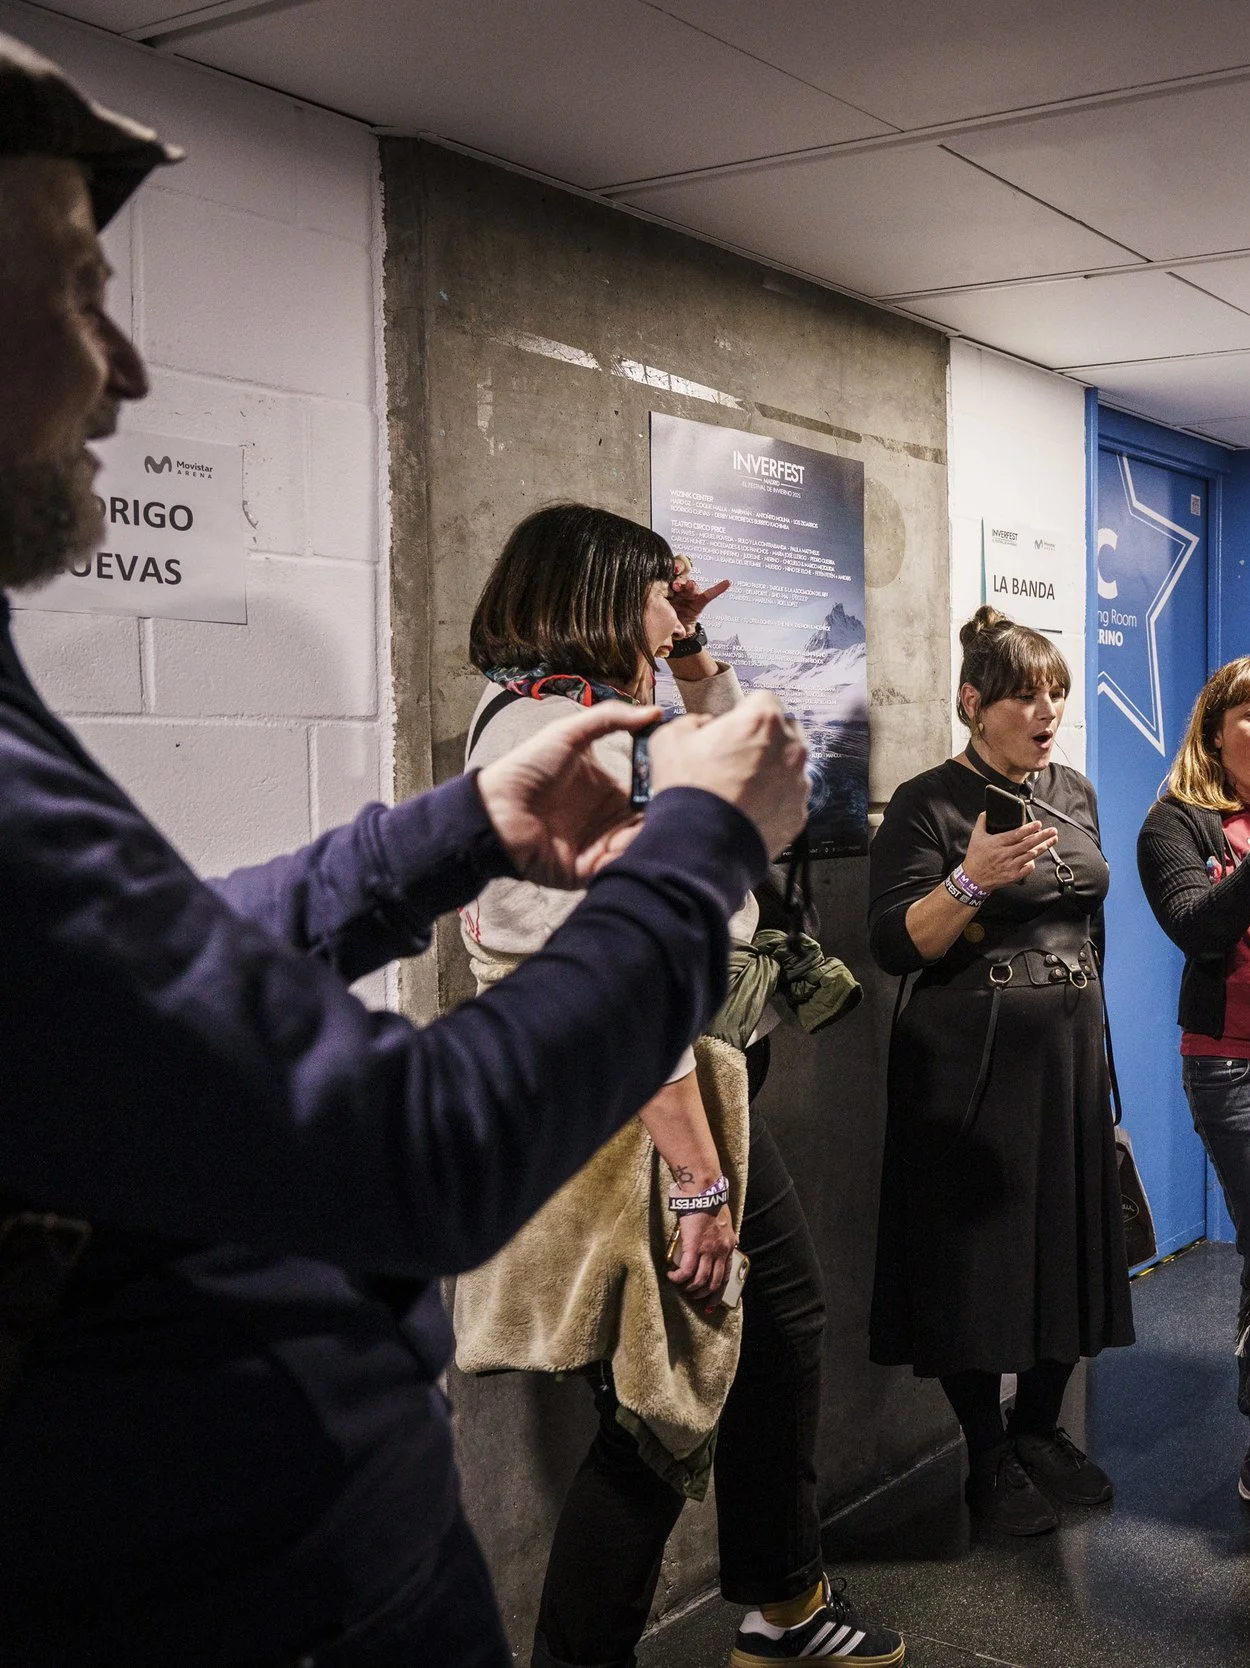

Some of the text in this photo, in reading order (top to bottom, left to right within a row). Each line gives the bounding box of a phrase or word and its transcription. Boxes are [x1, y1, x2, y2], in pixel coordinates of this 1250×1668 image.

[176, 460, 213, 472] Movistar
[733, 450, 805, 484] INVERFEST
[177, 470, 212, 479] ARENA
[763, 478, 780, 487] MADRID
[693, 494, 714, 502] CENTER
[671, 520, 692, 529] TEATRO
[711, 526, 726, 534] PRICE
[994, 574, 1055, 600] LA BANDA
[1111, 608, 1136, 627] Room
[670, 1191, 727, 1209] INVERFEST
